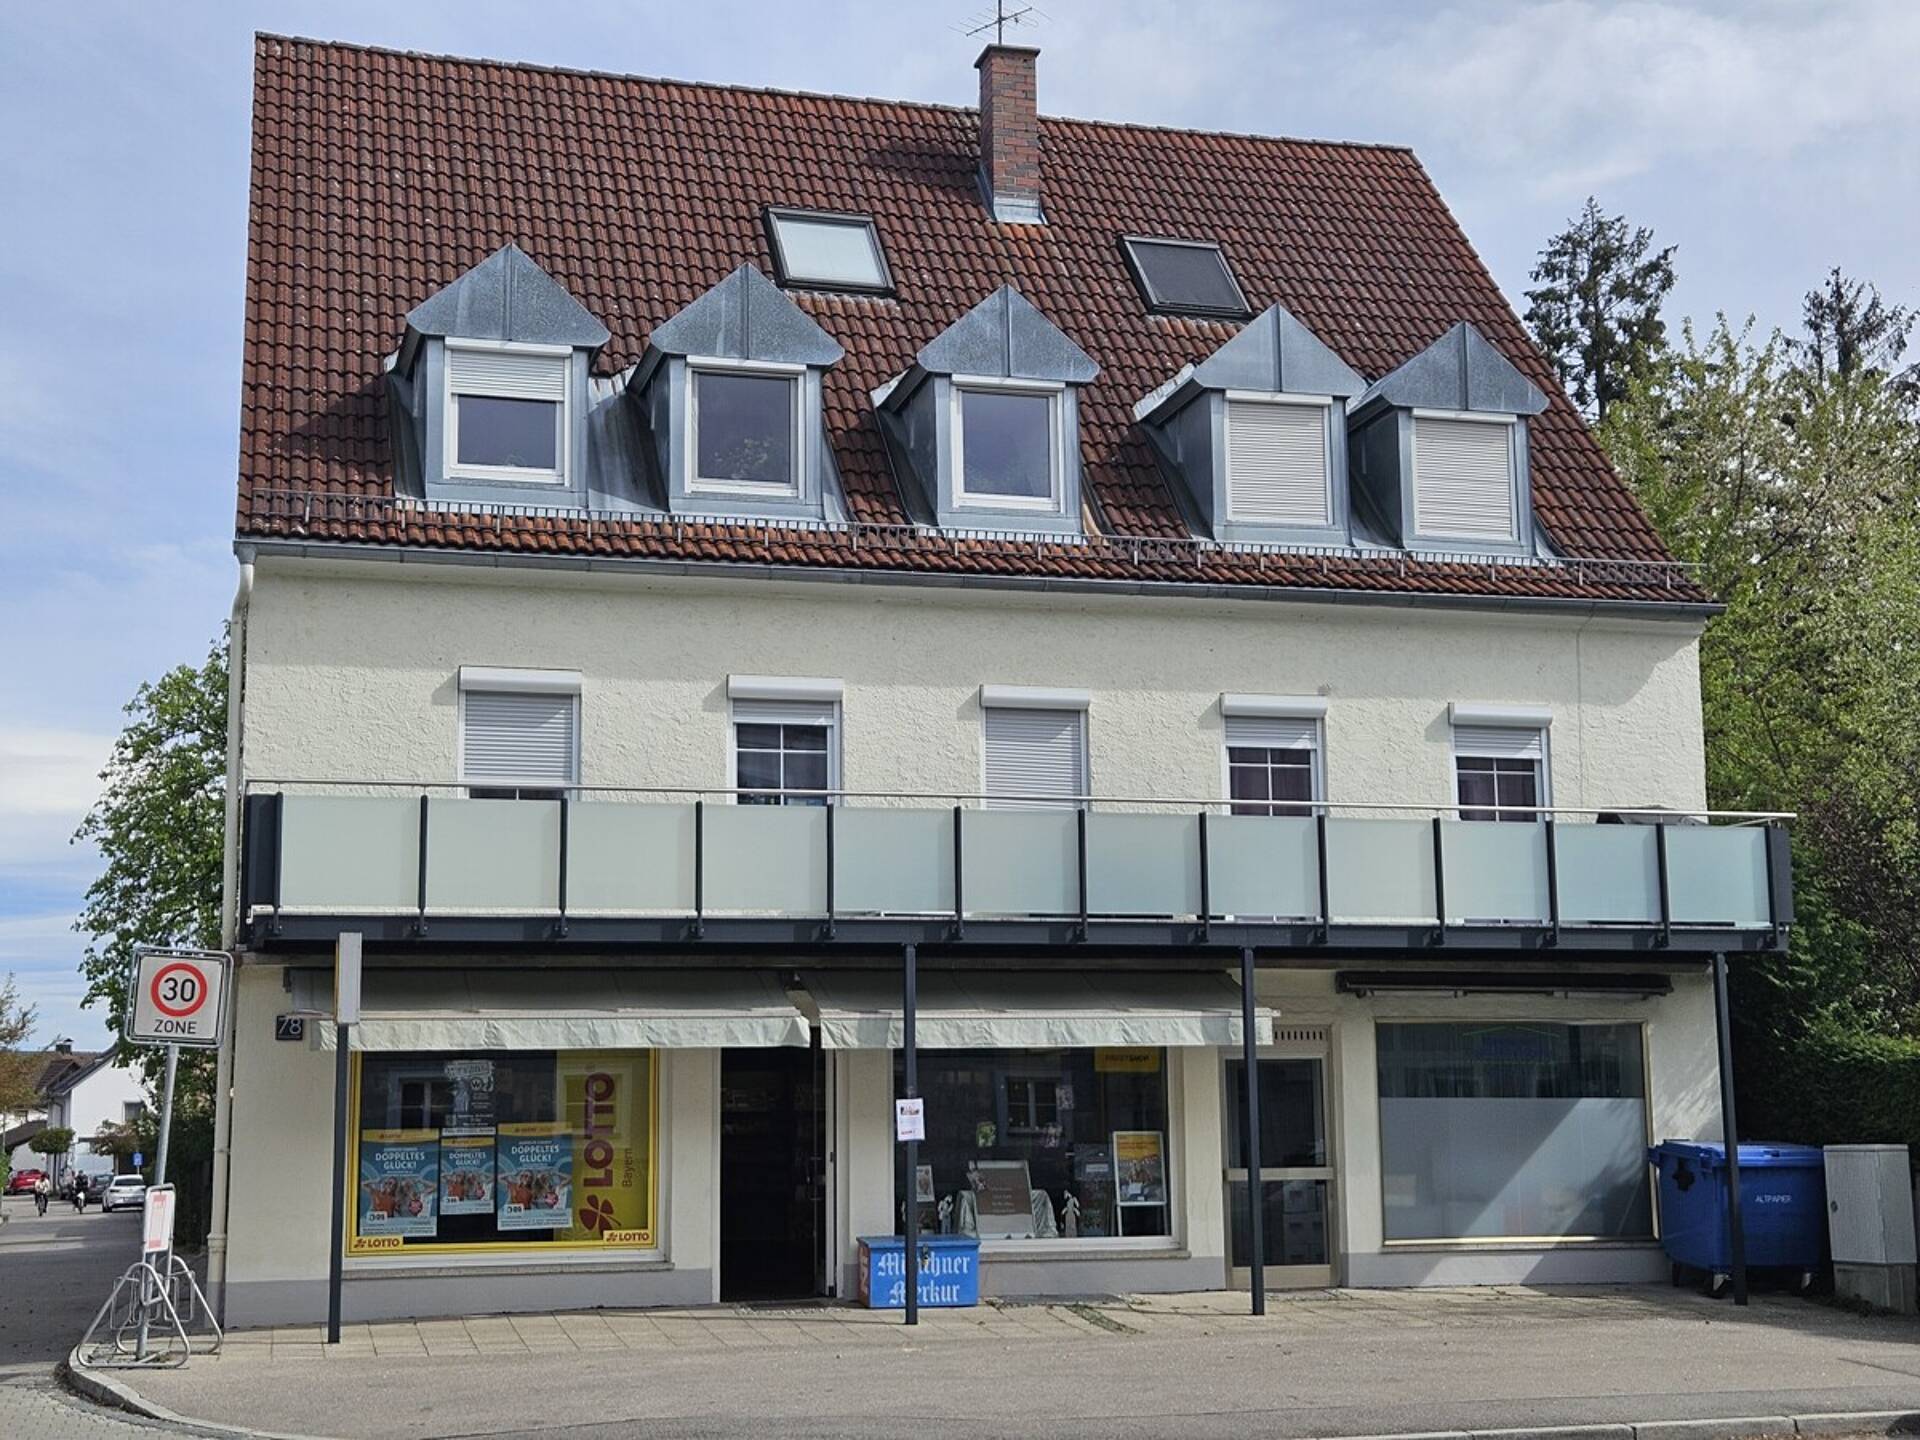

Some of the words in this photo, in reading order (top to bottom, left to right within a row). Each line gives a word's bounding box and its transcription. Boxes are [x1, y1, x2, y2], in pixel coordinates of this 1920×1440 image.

[163, 977, 196, 1002] 30
[154, 1020, 197, 1034] ZONE
[278, 1016, 302, 1035] 78
[584, 1072, 615, 1188] LOTTO
[374, 1151, 425, 1161] DOPPELTES
[511, 1144, 560, 1154] DOPPELTES
[622, 1147, 635, 1188] Bayern
[367, 1238, 400, 1249] LOTTO
[619, 1231, 649, 1242] LOTTO
